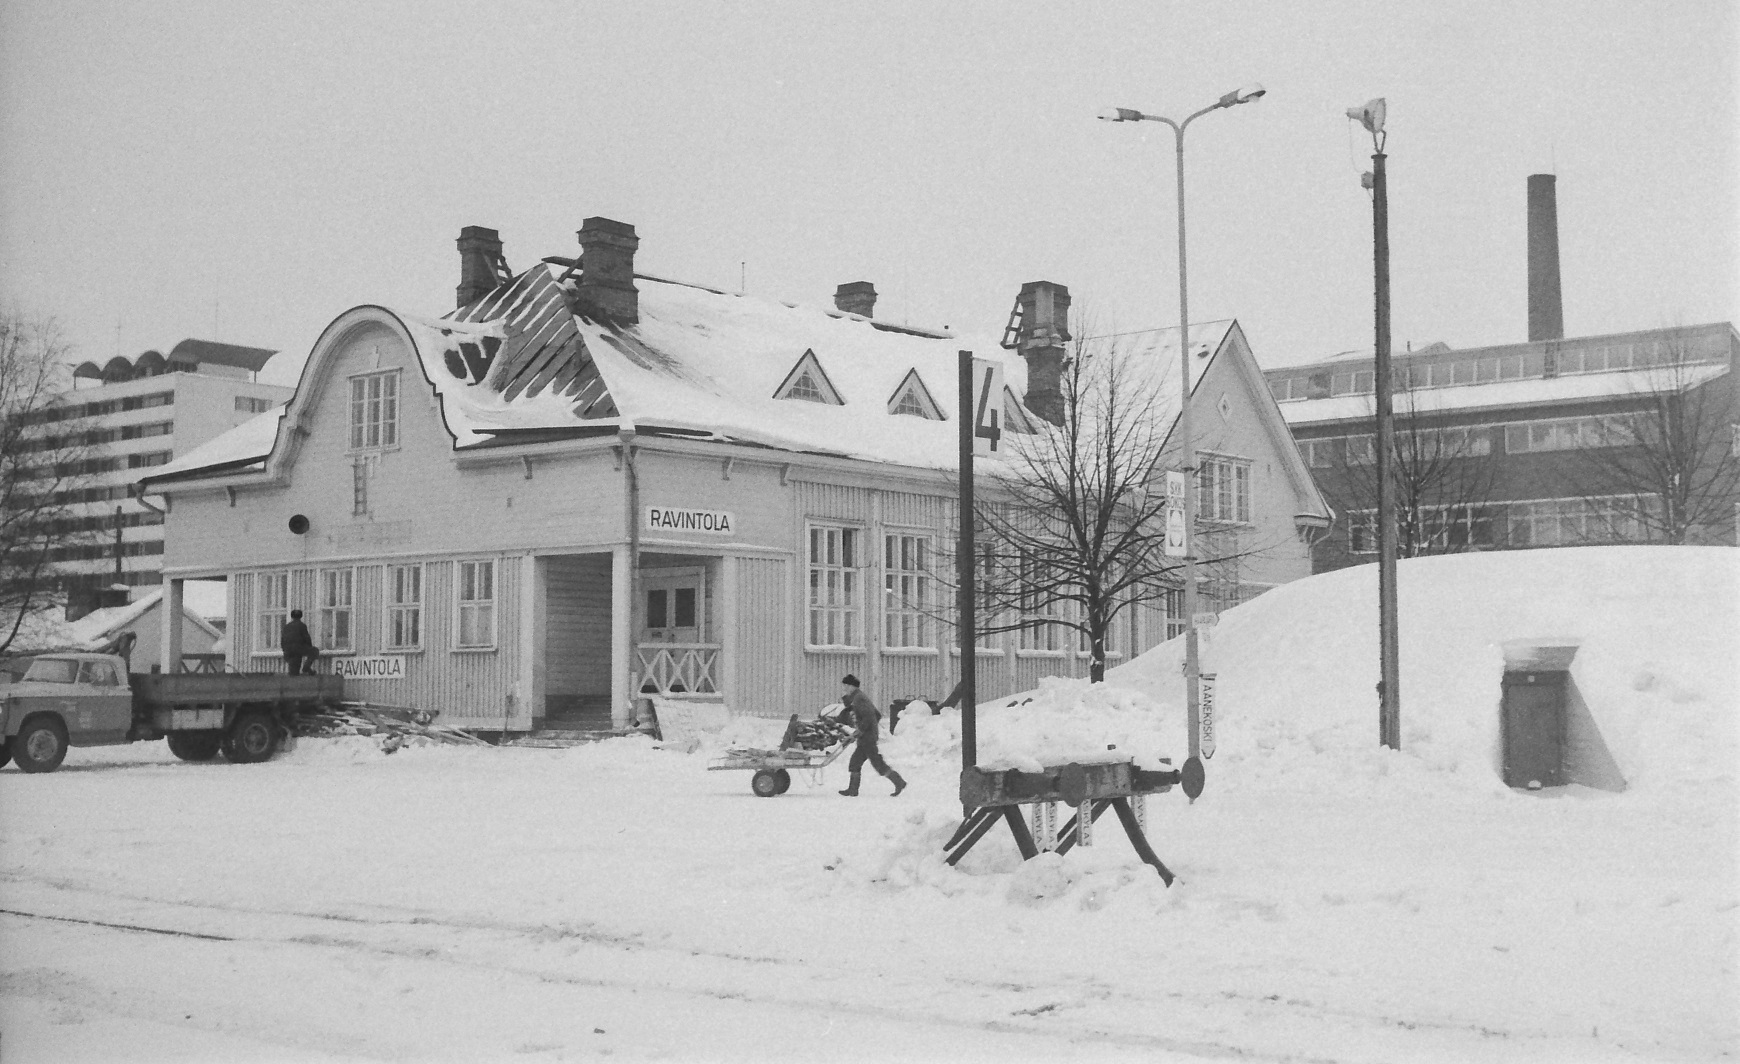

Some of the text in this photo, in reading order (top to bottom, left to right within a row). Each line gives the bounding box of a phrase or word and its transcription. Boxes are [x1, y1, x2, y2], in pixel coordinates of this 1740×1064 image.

[974, 366, 1001, 452] 4
[650, 509, 730, 532] RAVINTOLA
[334, 659, 401, 676] RAVINTOLA
